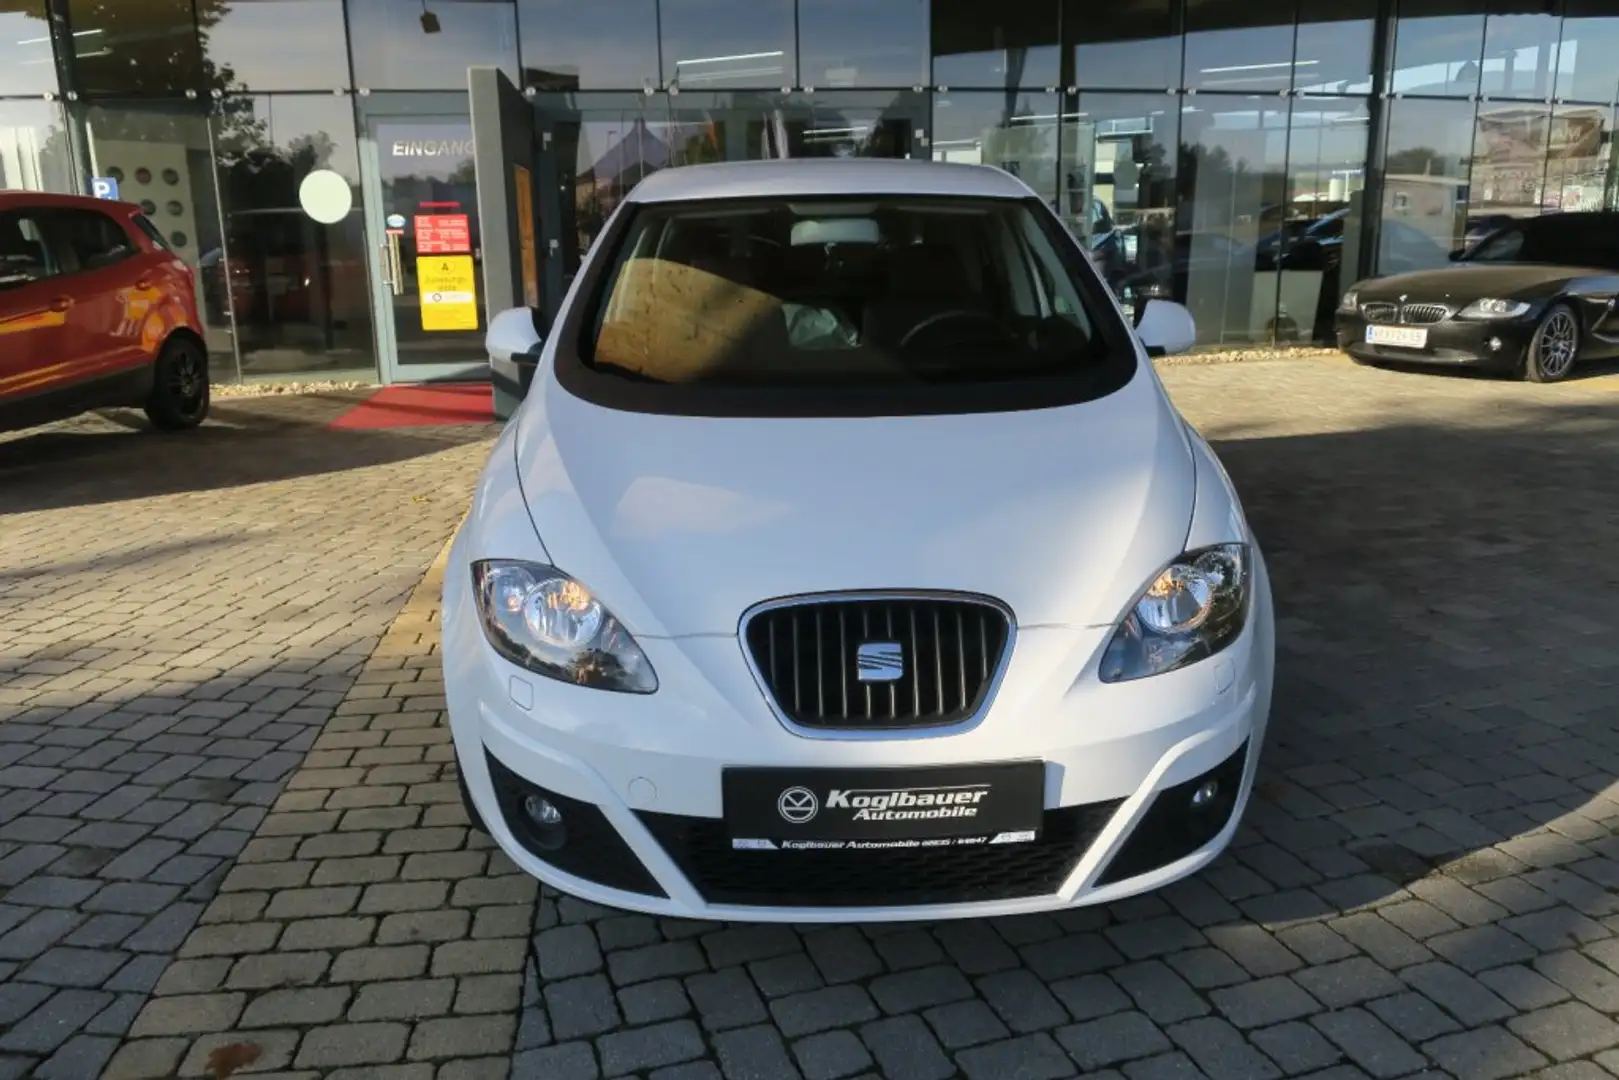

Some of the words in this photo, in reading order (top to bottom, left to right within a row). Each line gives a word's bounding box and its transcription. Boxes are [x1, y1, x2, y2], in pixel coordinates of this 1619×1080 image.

[93, 181, 111, 199] P
[825, 788, 989, 811] Koglbauer
[852, 806, 978, 820] Automobile
